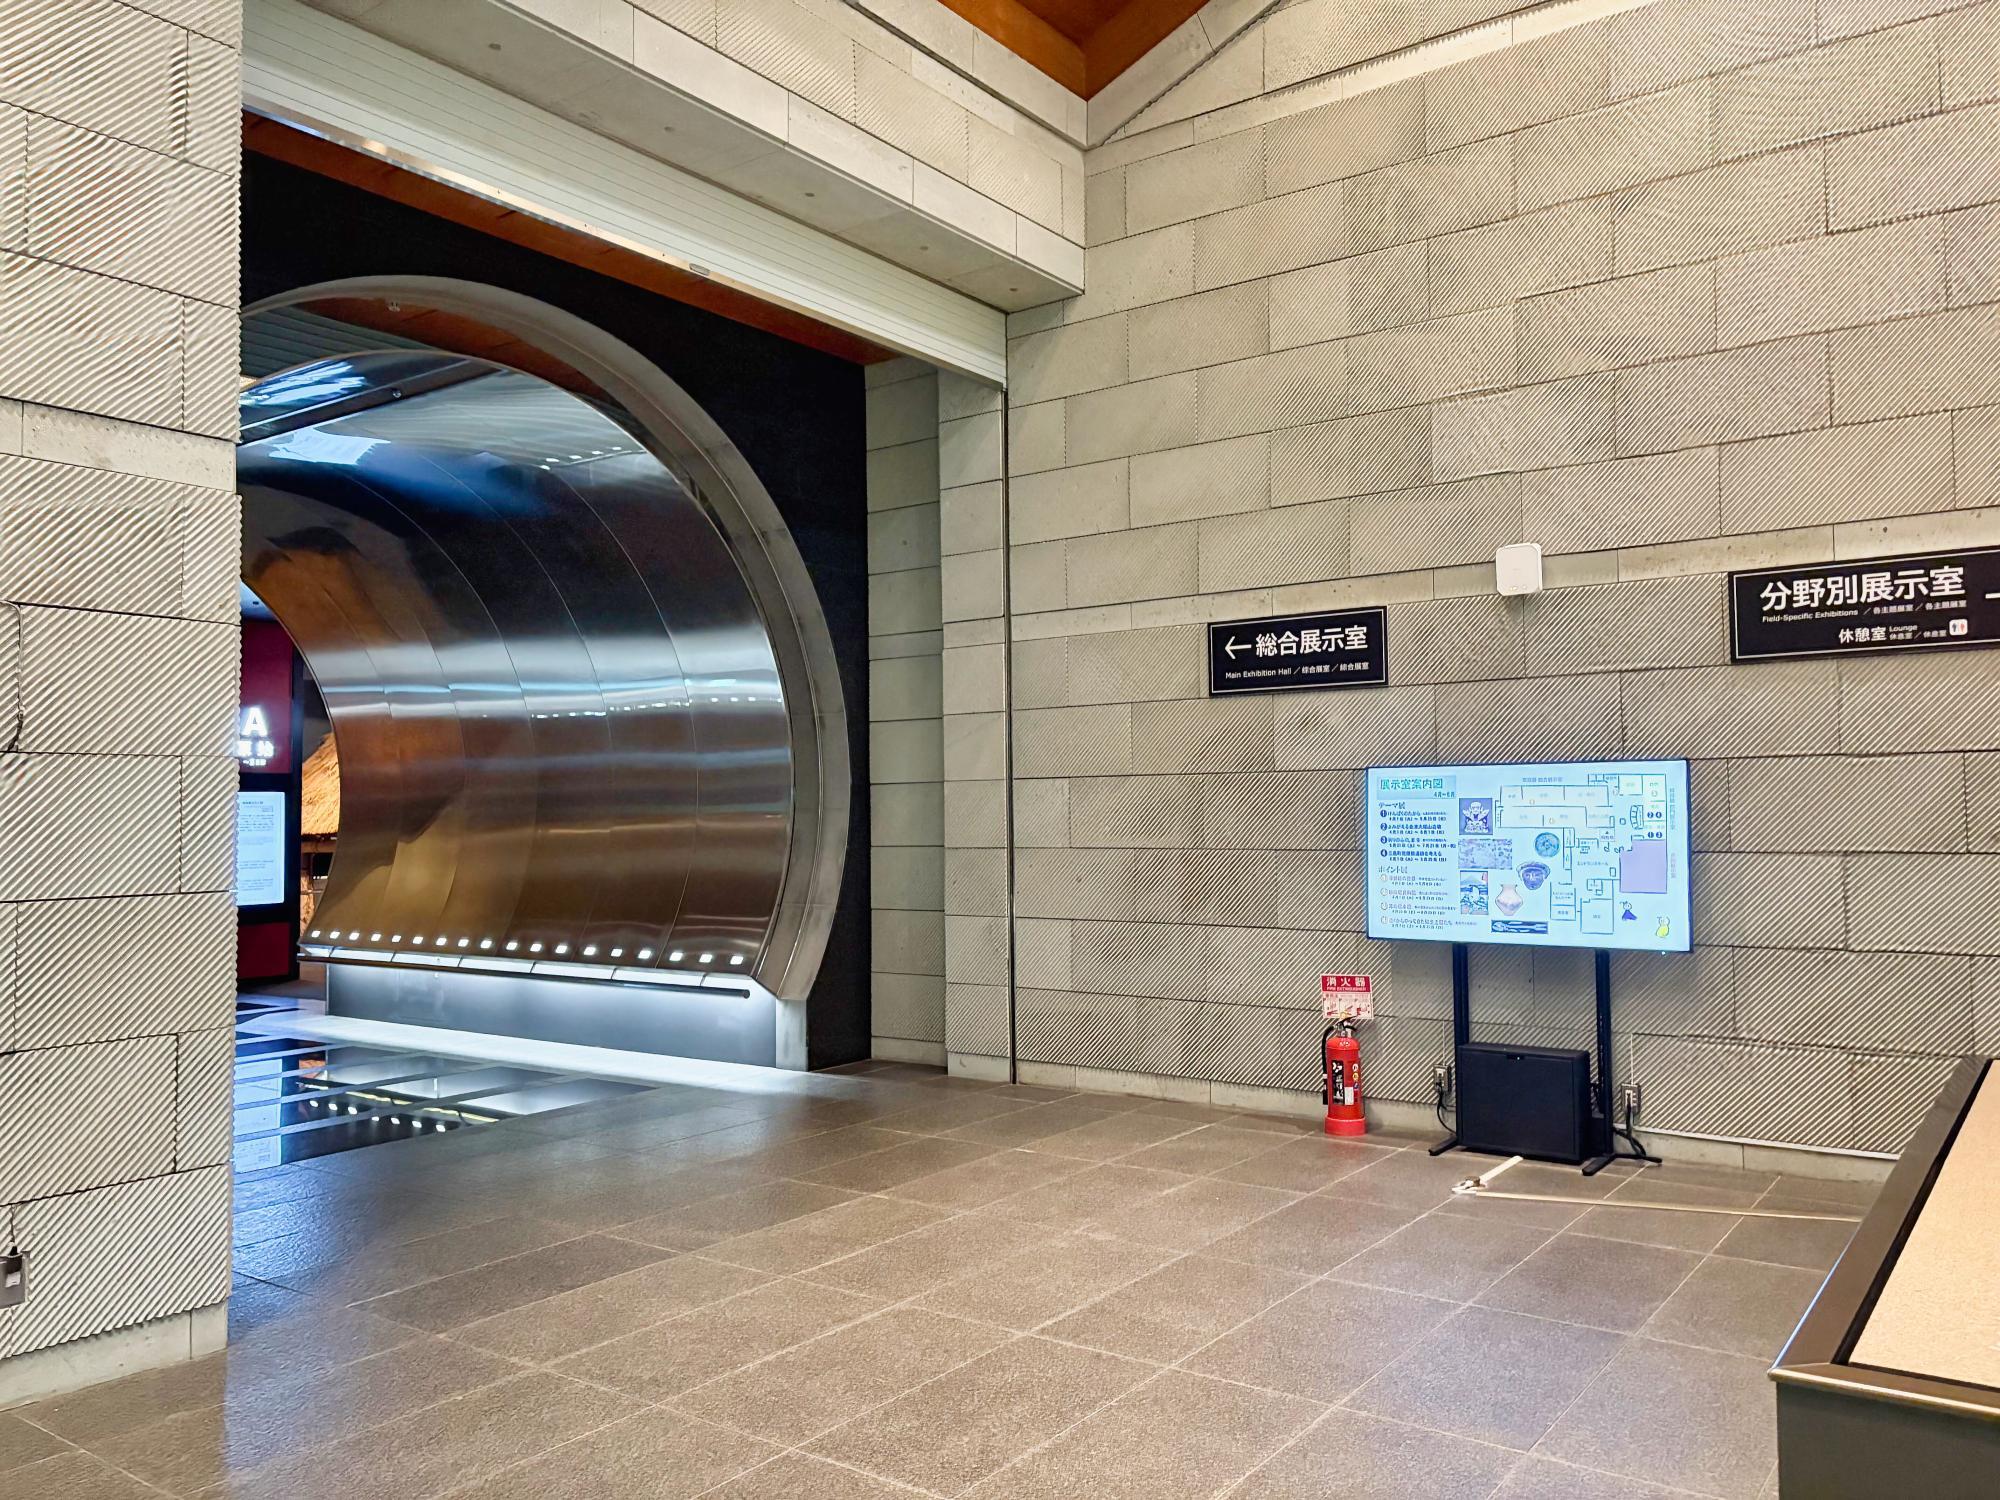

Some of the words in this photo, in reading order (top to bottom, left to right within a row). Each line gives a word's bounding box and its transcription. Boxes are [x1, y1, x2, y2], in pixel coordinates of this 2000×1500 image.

[1760, 566, 1966, 611] 分野別展示室
[1762, 613, 1813, 623] Field-Specific
[1815, 609, 1858, 619] Exhibitions
[1255, 625, 1368, 658] 総合展示室
[1838, 626, 1887, 644] 休憩室
[1225, 671, 1241, 680] Main
[1243, 669, 1277, 678] Exhibition
[1278, 668, 1292, 676] Hall
[1326, 976, 1366, 987] 消火器
